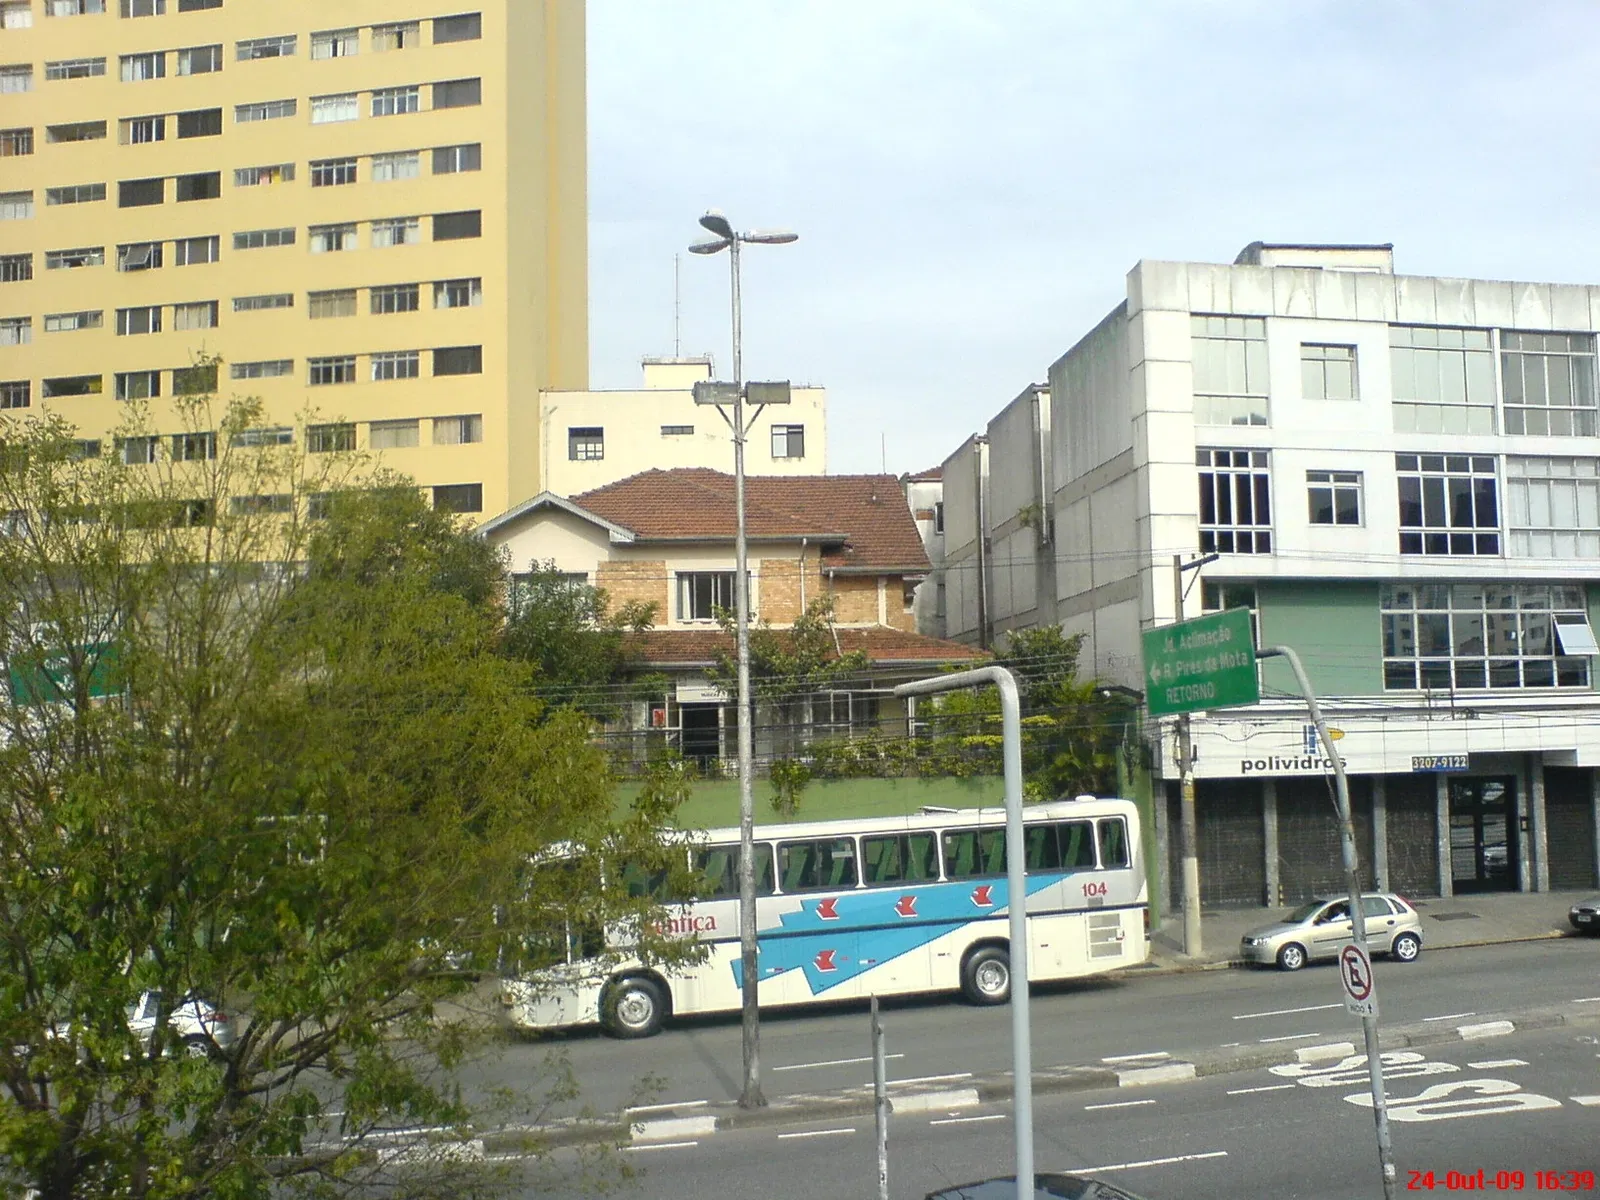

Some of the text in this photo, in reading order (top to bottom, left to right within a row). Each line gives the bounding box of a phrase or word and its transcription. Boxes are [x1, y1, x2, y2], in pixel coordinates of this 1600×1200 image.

[1176, 661, 1202, 676] Pires
[1220, 650, 1248, 669] Mota
[1166, 681, 1215, 704] RETORNO
[1241, 755, 1347, 774] polividros
[1413, 756, 1467, 769] 3207-9122
[1081, 882, 1107, 897] 104
